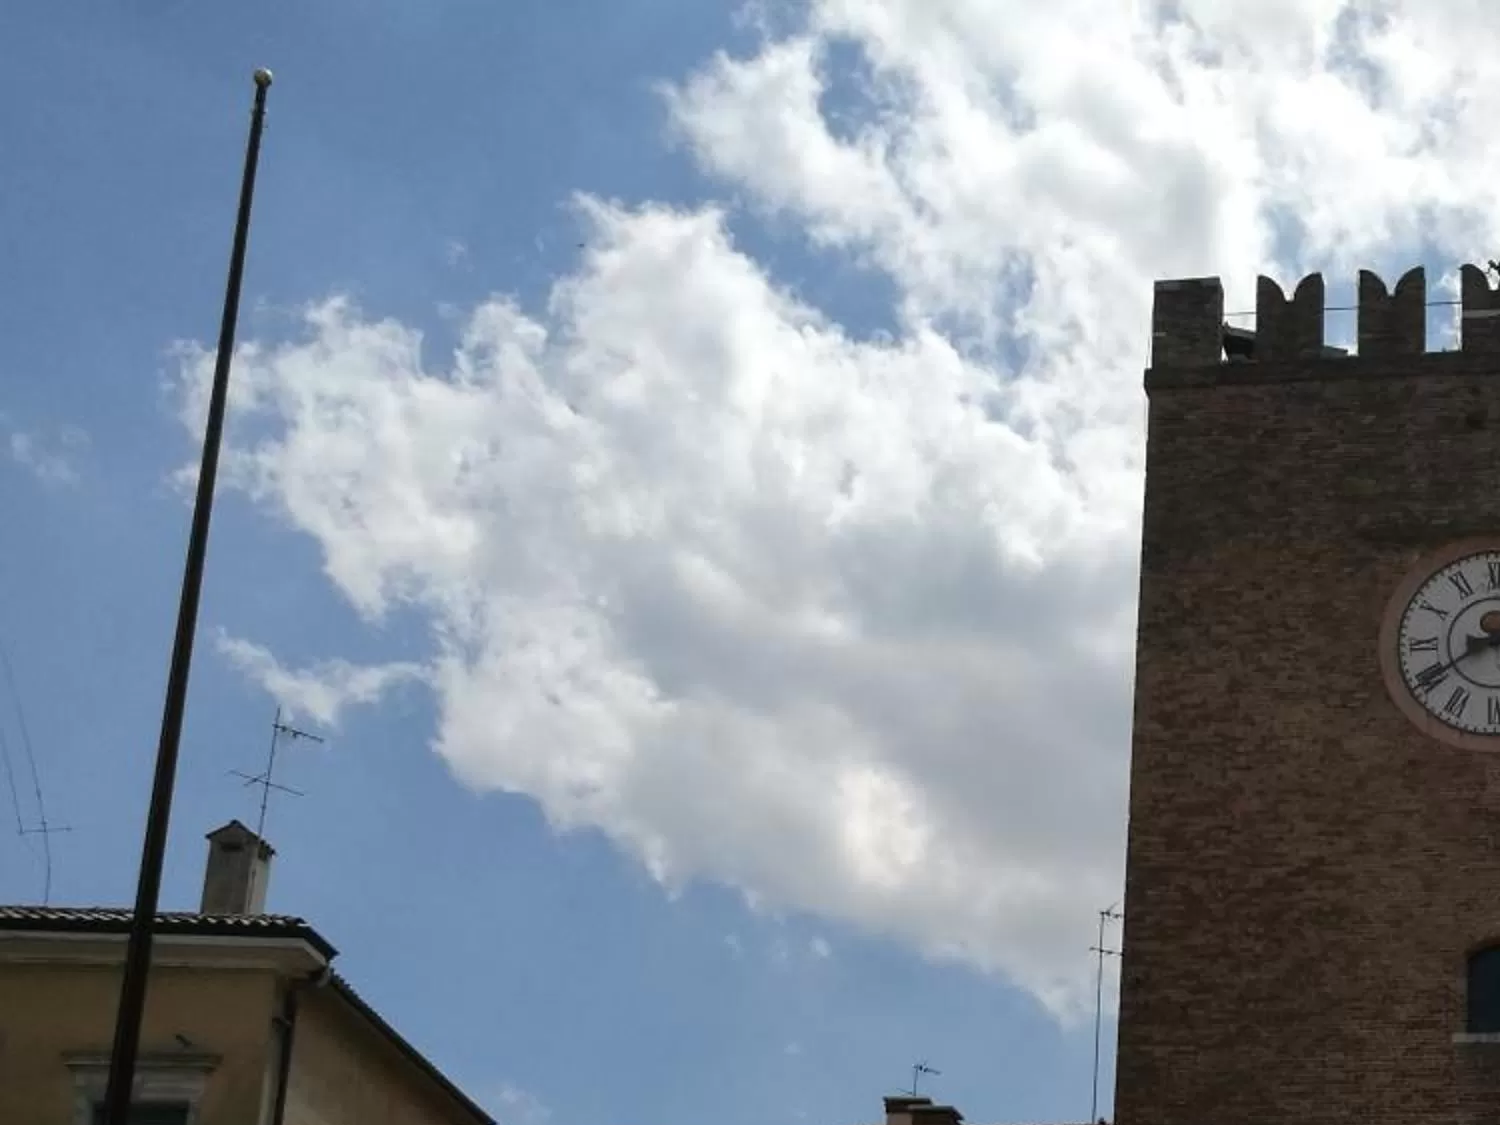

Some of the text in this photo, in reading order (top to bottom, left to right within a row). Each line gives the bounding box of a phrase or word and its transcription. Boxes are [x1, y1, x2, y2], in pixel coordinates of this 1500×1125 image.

[1448, 571, 1474, 600] XI
[1419, 600, 1449, 621] X
[1409, 636, 1439, 652] IX
[1444, 687, 1470, 718] VII
